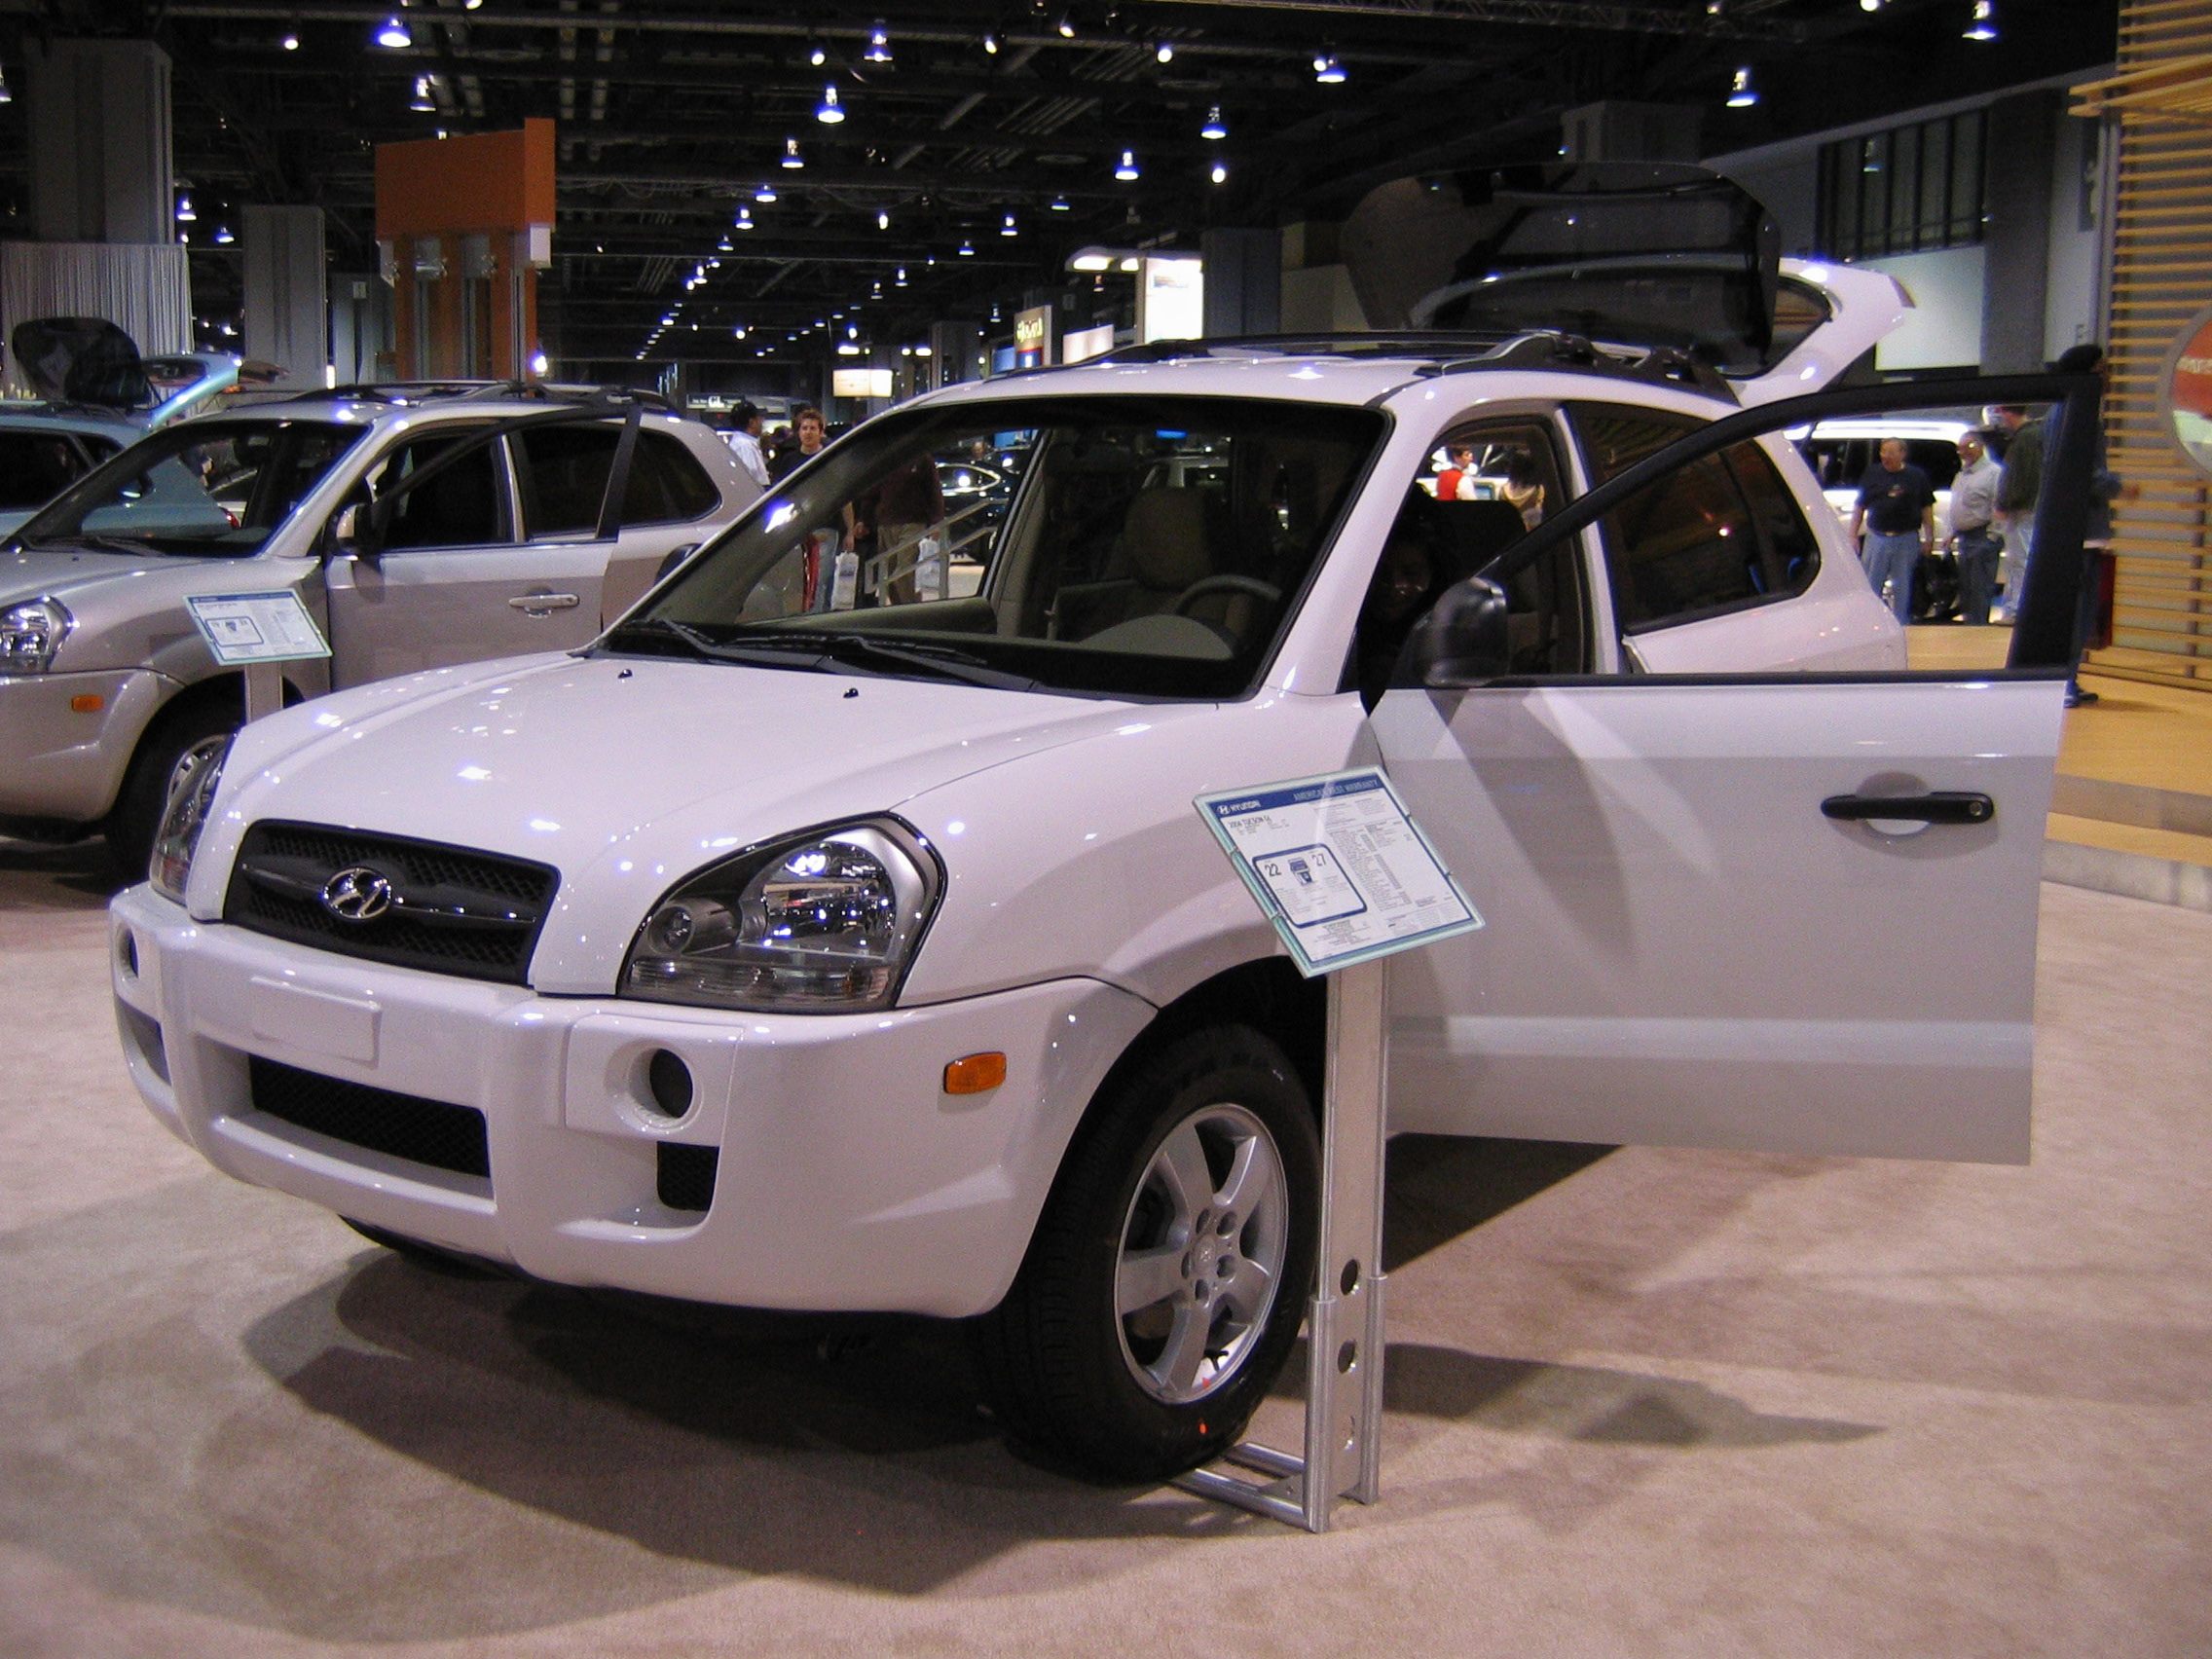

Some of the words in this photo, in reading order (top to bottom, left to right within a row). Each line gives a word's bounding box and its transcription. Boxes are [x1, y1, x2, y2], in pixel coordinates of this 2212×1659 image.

[1231, 799, 1261, 814] HYUNDAI
[1311, 853, 1326, 866] 27
[1265, 863, 1281, 877] 22
